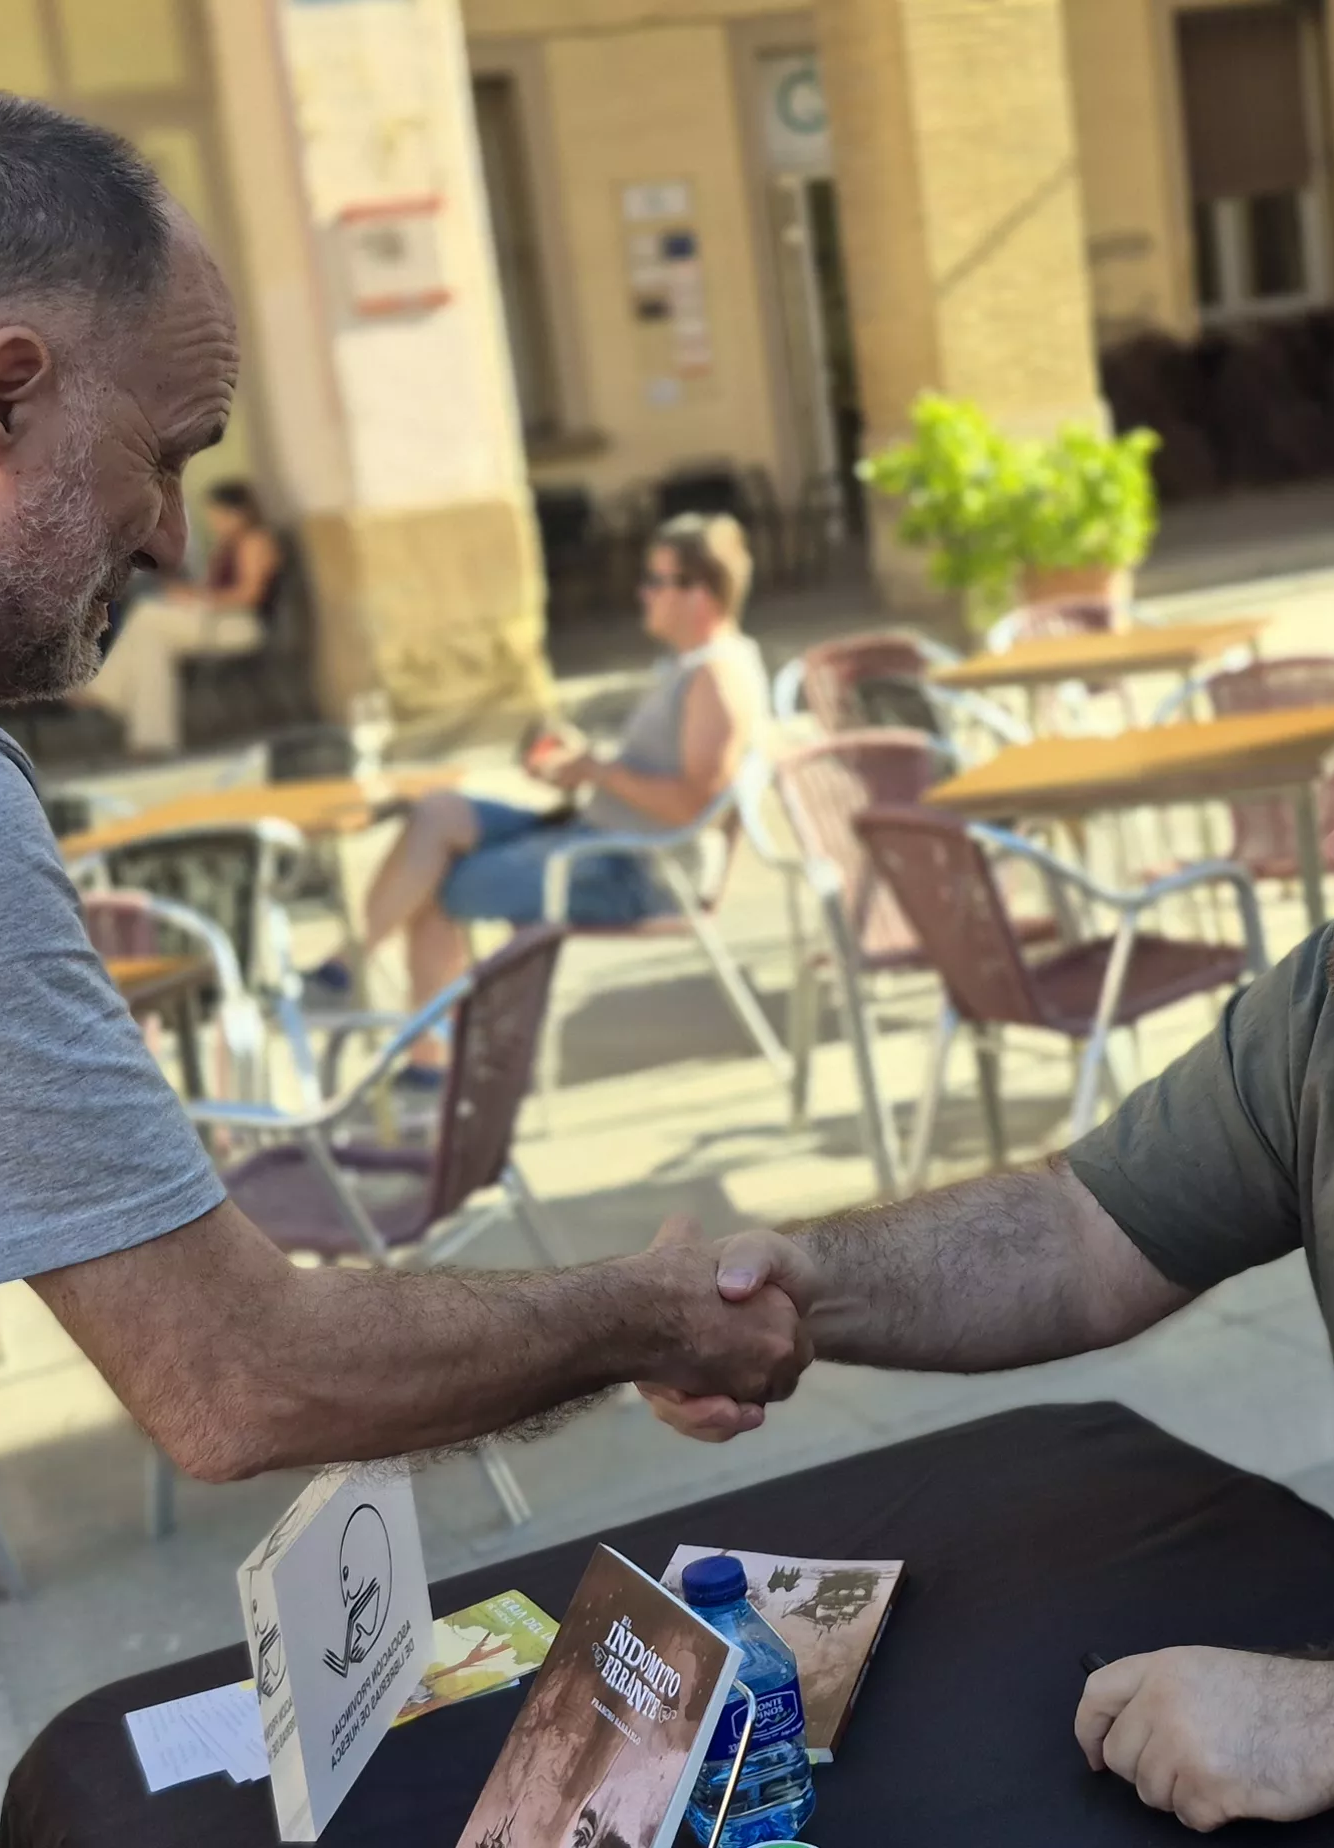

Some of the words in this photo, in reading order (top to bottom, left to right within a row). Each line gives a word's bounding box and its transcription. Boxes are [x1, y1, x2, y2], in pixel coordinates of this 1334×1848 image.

[620, 1614, 633, 1630] EL
[604, 1620, 681, 1698] INDÓMITO
[600, 1654, 662, 1720] ERRANTE
[757, 1696, 783, 1711] ONTE
